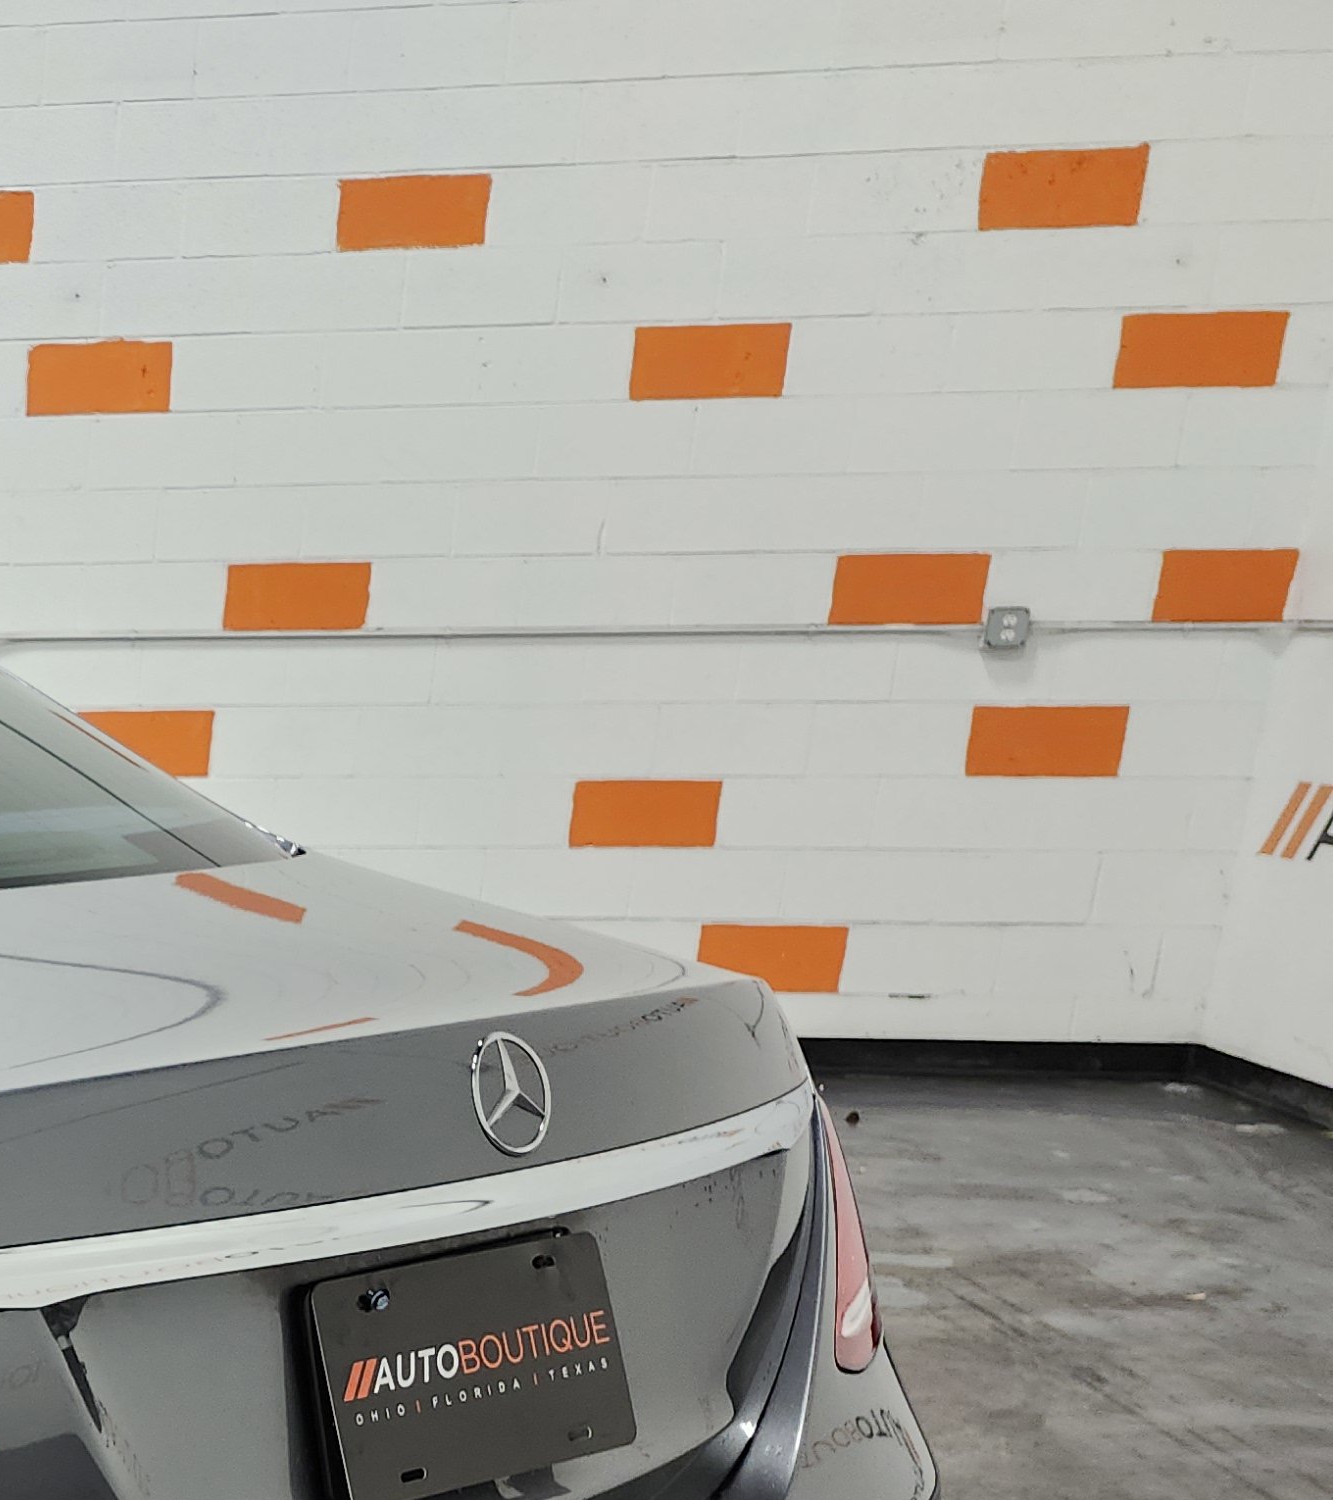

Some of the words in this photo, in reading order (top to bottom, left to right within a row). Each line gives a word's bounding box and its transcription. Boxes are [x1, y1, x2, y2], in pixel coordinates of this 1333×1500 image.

[355, 1403, 406, 1427] OHIO
[431, 1377, 522, 1409] FLORIDA
[548, 1356, 609, 1382] TEXAS
